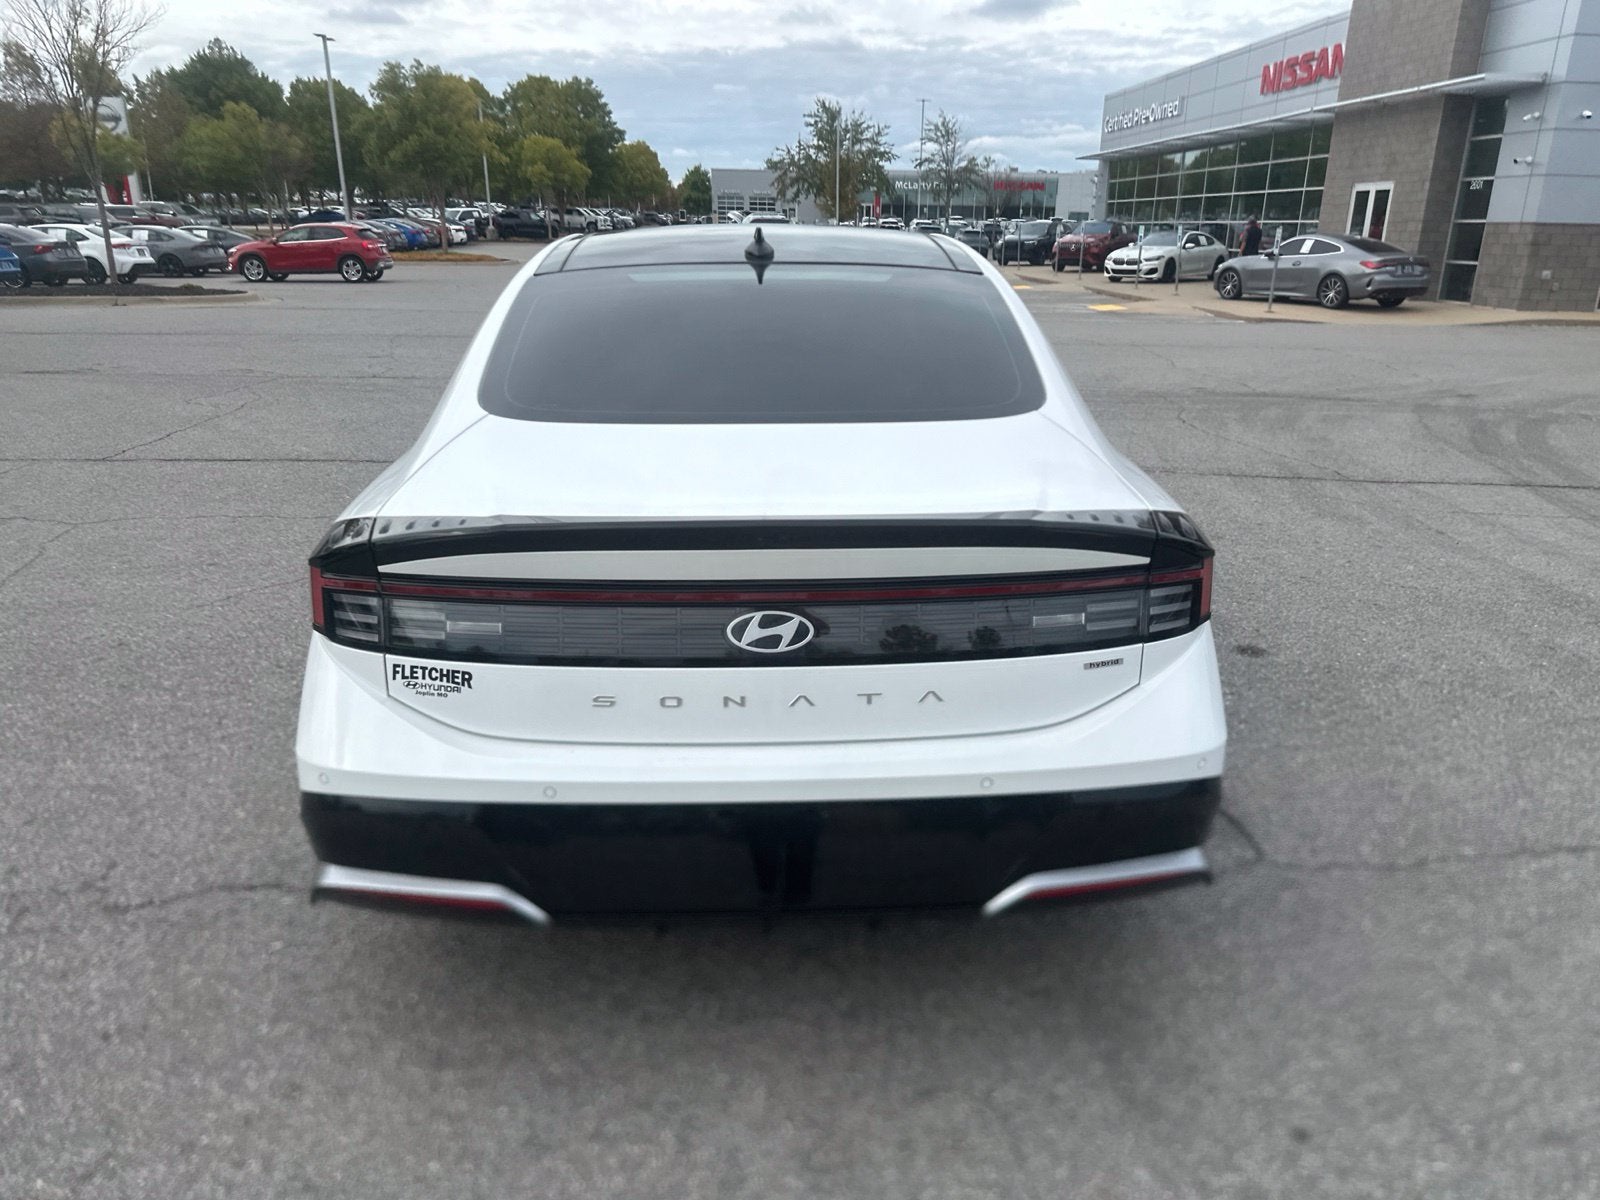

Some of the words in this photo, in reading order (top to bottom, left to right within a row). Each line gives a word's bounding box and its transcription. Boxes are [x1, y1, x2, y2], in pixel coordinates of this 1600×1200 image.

[1260, 43, 1345, 96] NISSAN
[1104, 110, 1133, 133] Certified
[1089, 659, 1119, 668] hybrid
[392, 663, 473, 689] FLETCHER
[420, 683, 462, 694] HYUNDAI
[592, 690, 944, 708] SONATA
